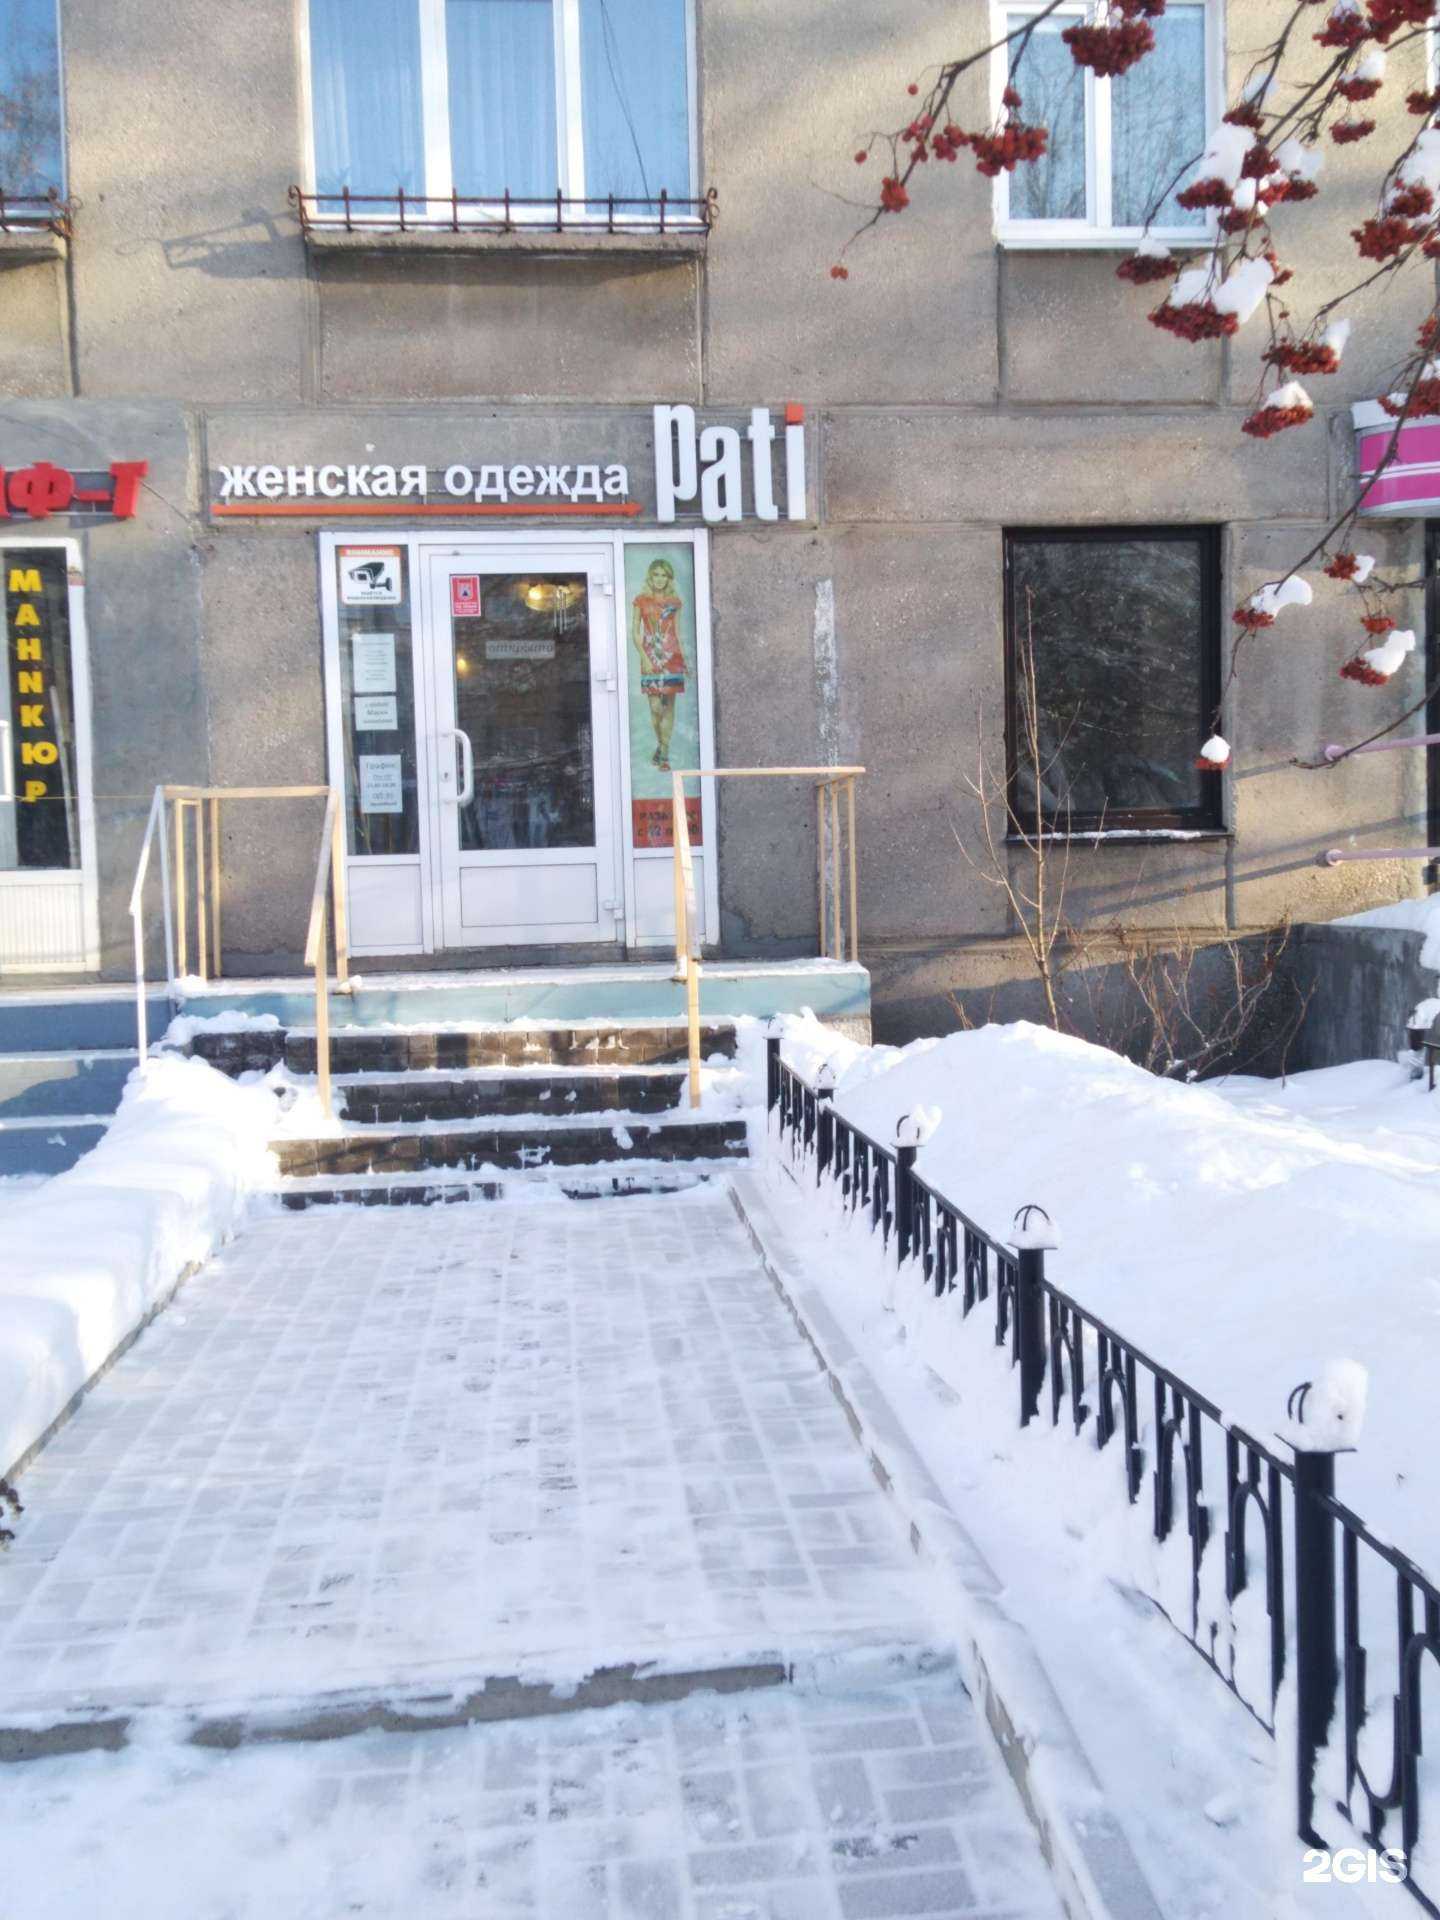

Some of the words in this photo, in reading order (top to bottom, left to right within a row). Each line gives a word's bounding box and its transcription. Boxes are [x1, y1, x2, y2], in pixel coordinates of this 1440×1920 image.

[218, 463, 428, 498] женская
[444, 464, 629, 503] одежда
[653, 402, 807, 522] pati
